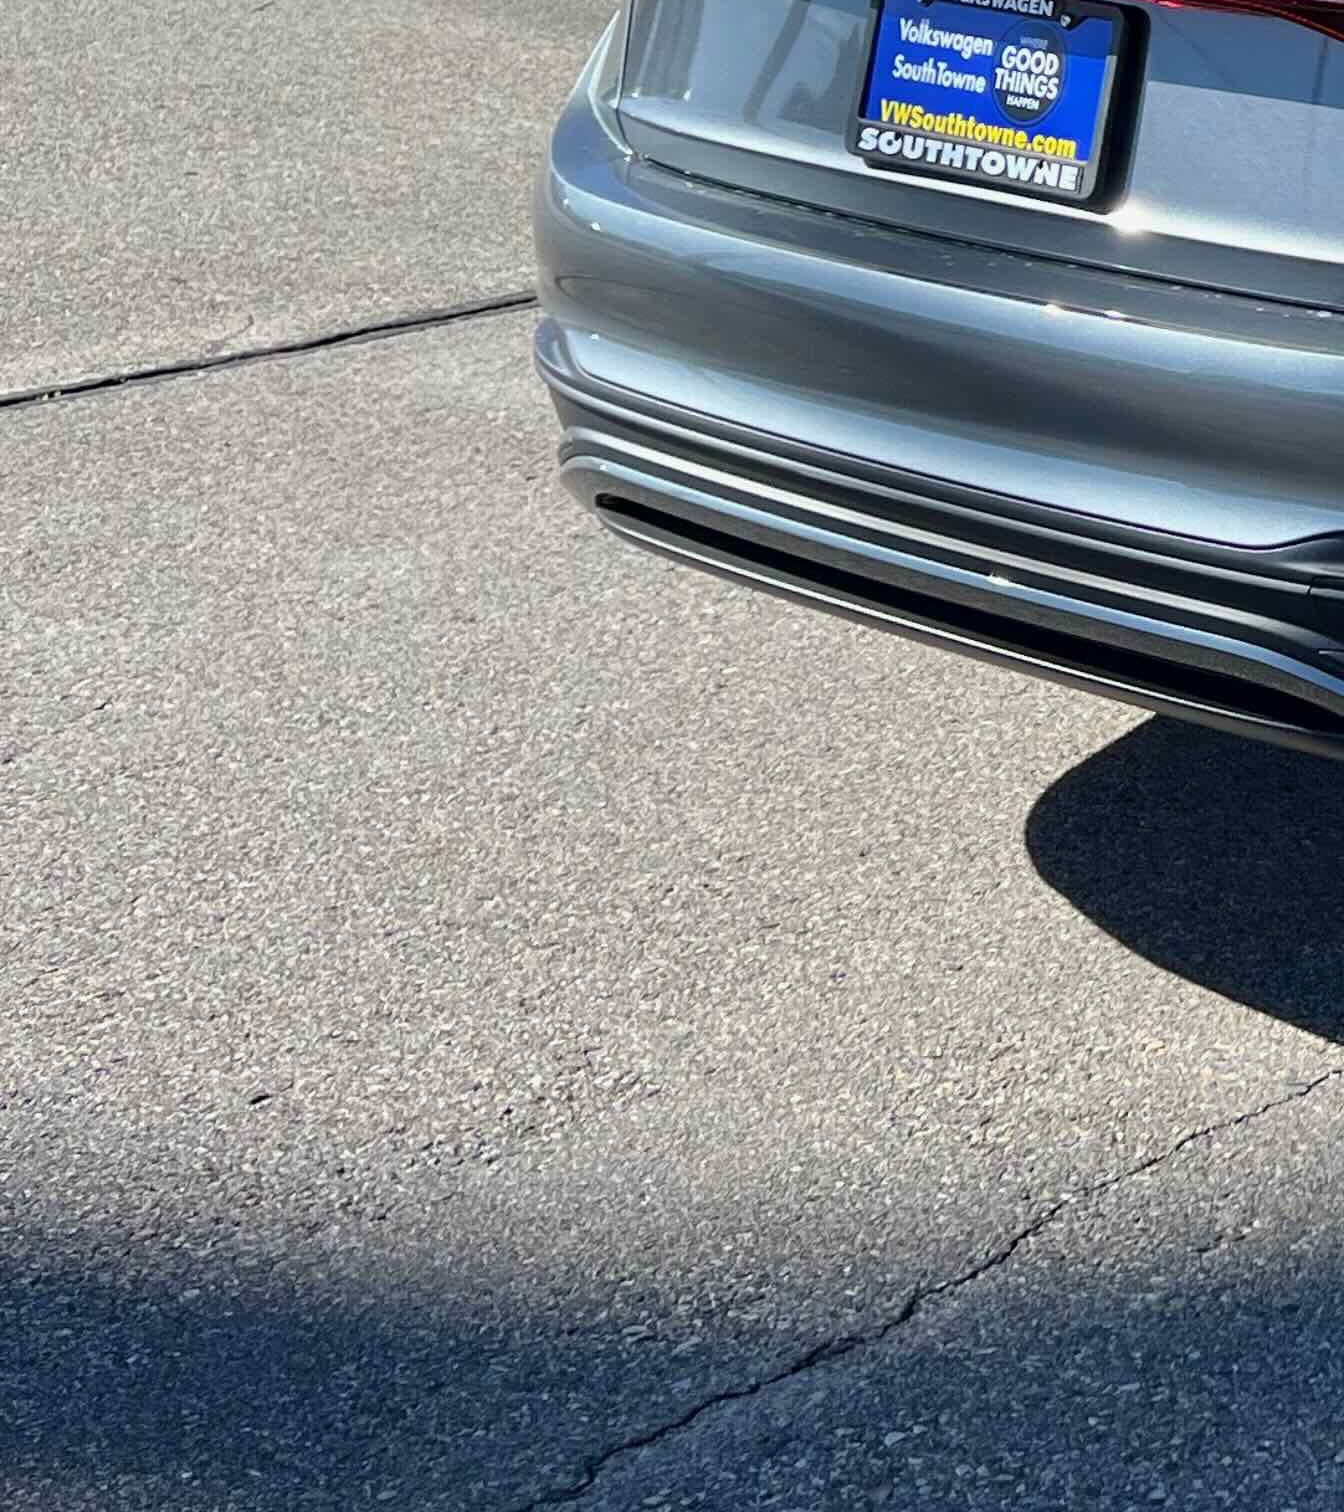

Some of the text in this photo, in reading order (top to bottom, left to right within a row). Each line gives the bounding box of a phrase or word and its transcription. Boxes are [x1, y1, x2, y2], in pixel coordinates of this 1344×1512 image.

[899, 17, 993, 60] Volkswagen
[1002, 45, 1060, 76] GOOD
[994, 67, 1060, 100] THINGS
[880, 98, 1078, 159] VWSouthtowne.com
[857, 126, 1079, 191] SOUTHTOWNE
